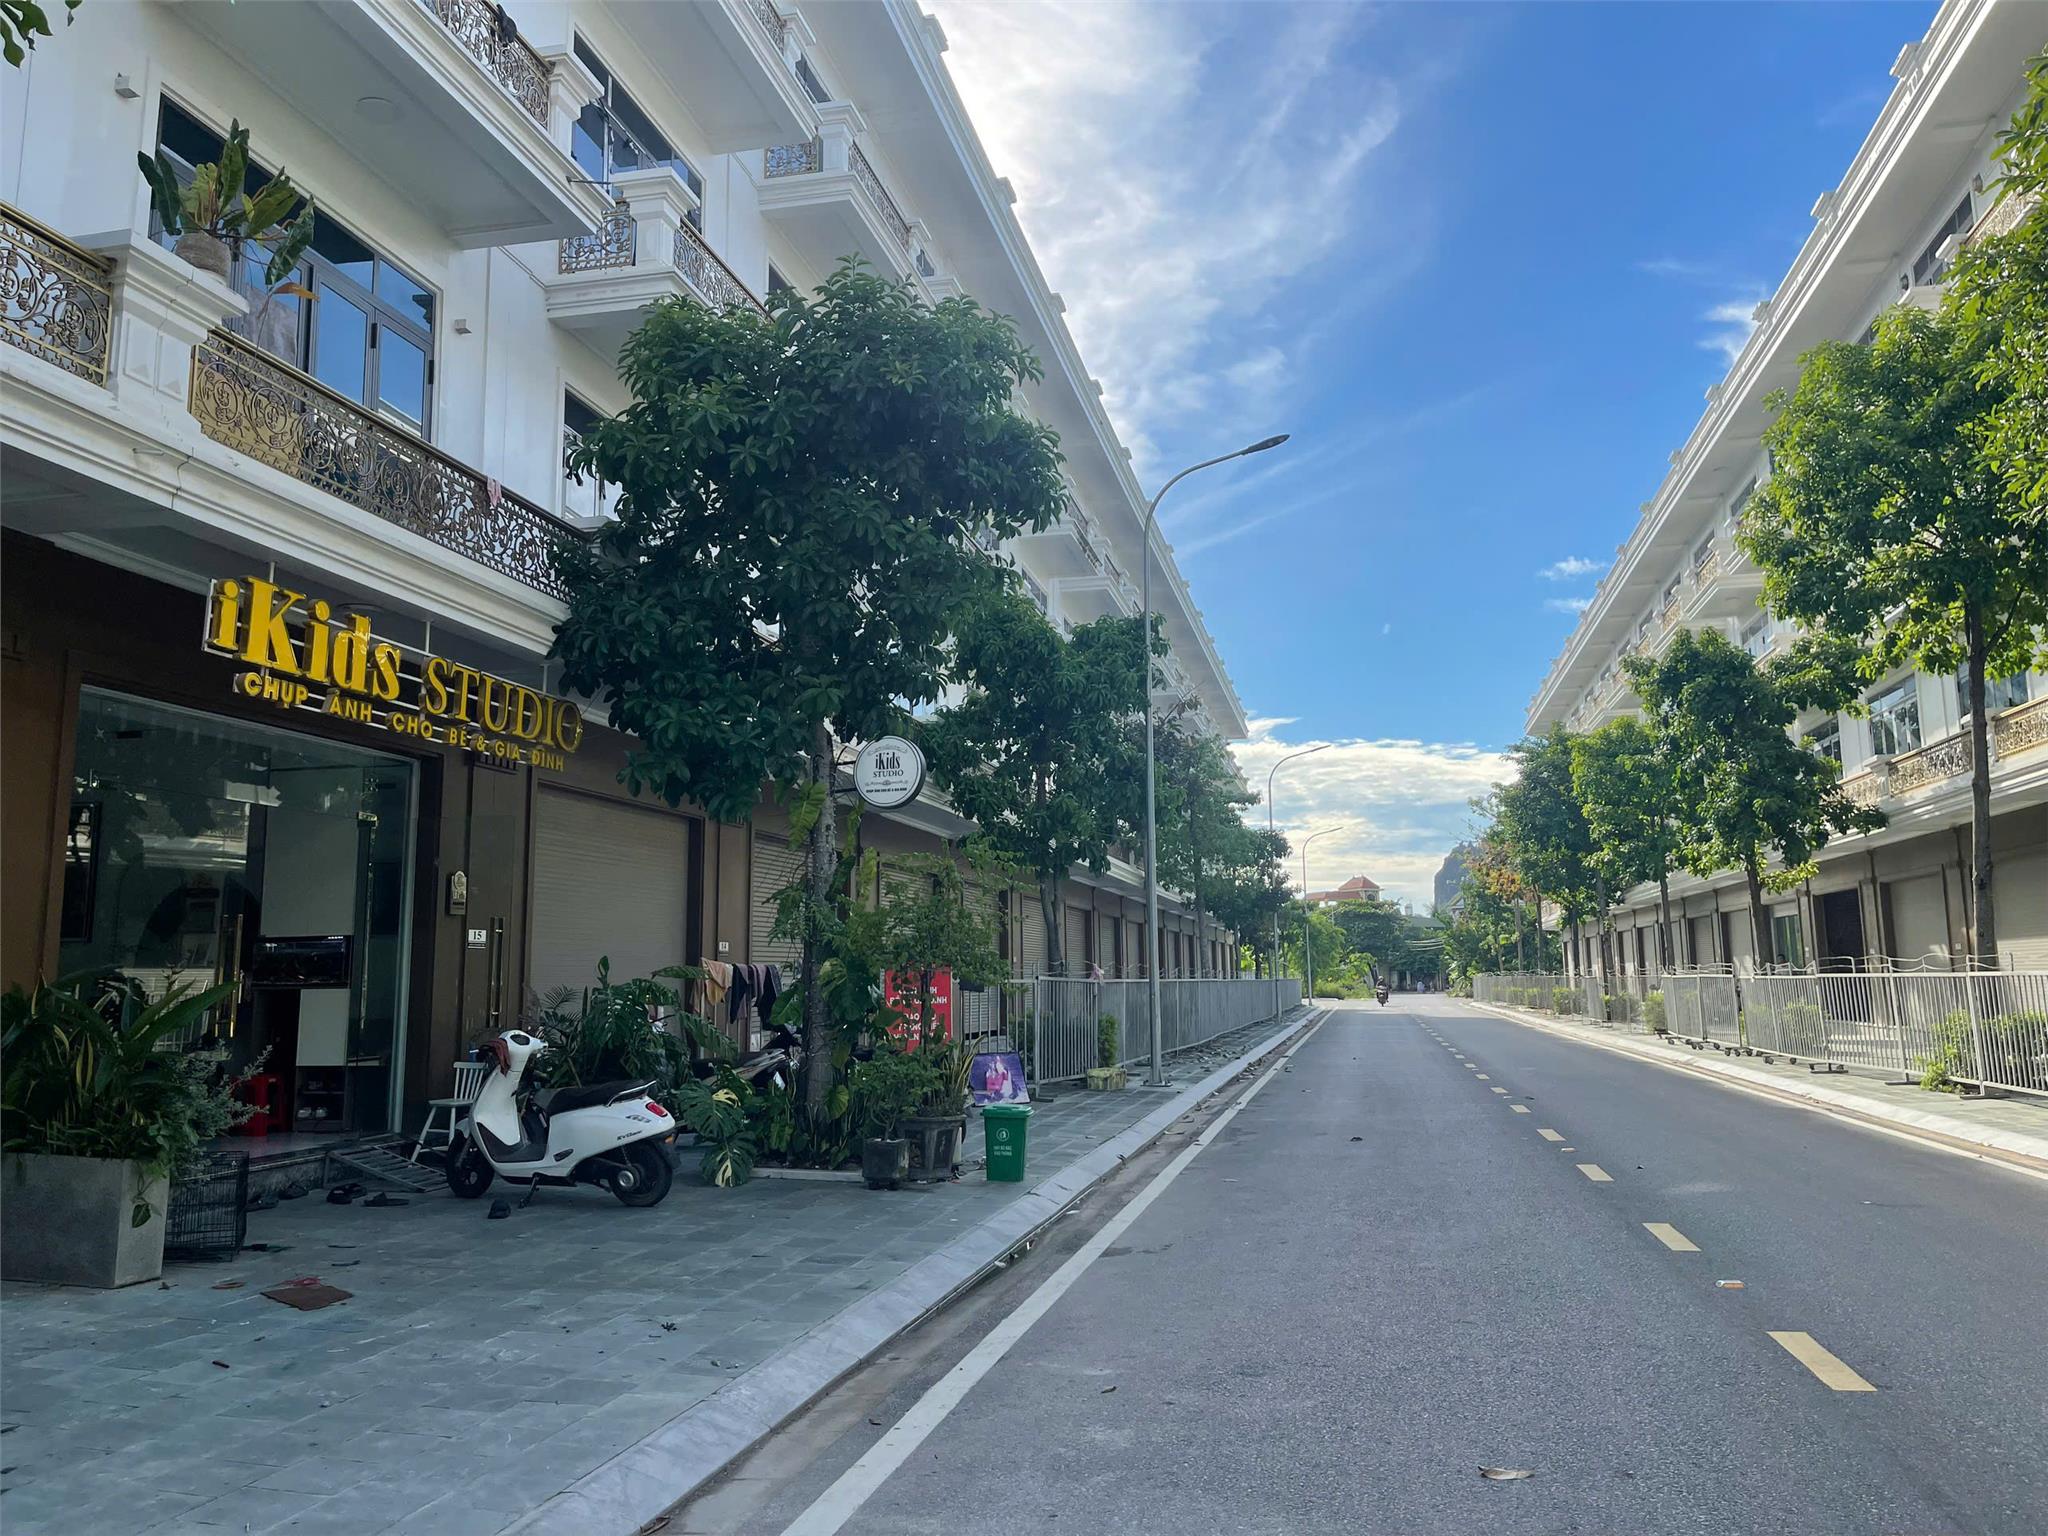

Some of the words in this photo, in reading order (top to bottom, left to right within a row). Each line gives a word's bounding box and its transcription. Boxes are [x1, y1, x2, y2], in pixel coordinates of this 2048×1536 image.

[208, 576, 400, 701] iKids
[424, 657, 583, 752] STUDIO
[243, 671, 308, 709] CHỤP
[392, 712, 433, 738] CHO
[449, 724, 467, 747] BÉ
[476, 734, 486, 752] &
[495, 740, 521, 761] GIA
[875, 751, 901, 770] iKids
[873, 769, 904, 778] STUDIO
[473, 931, 482, 940] 15
